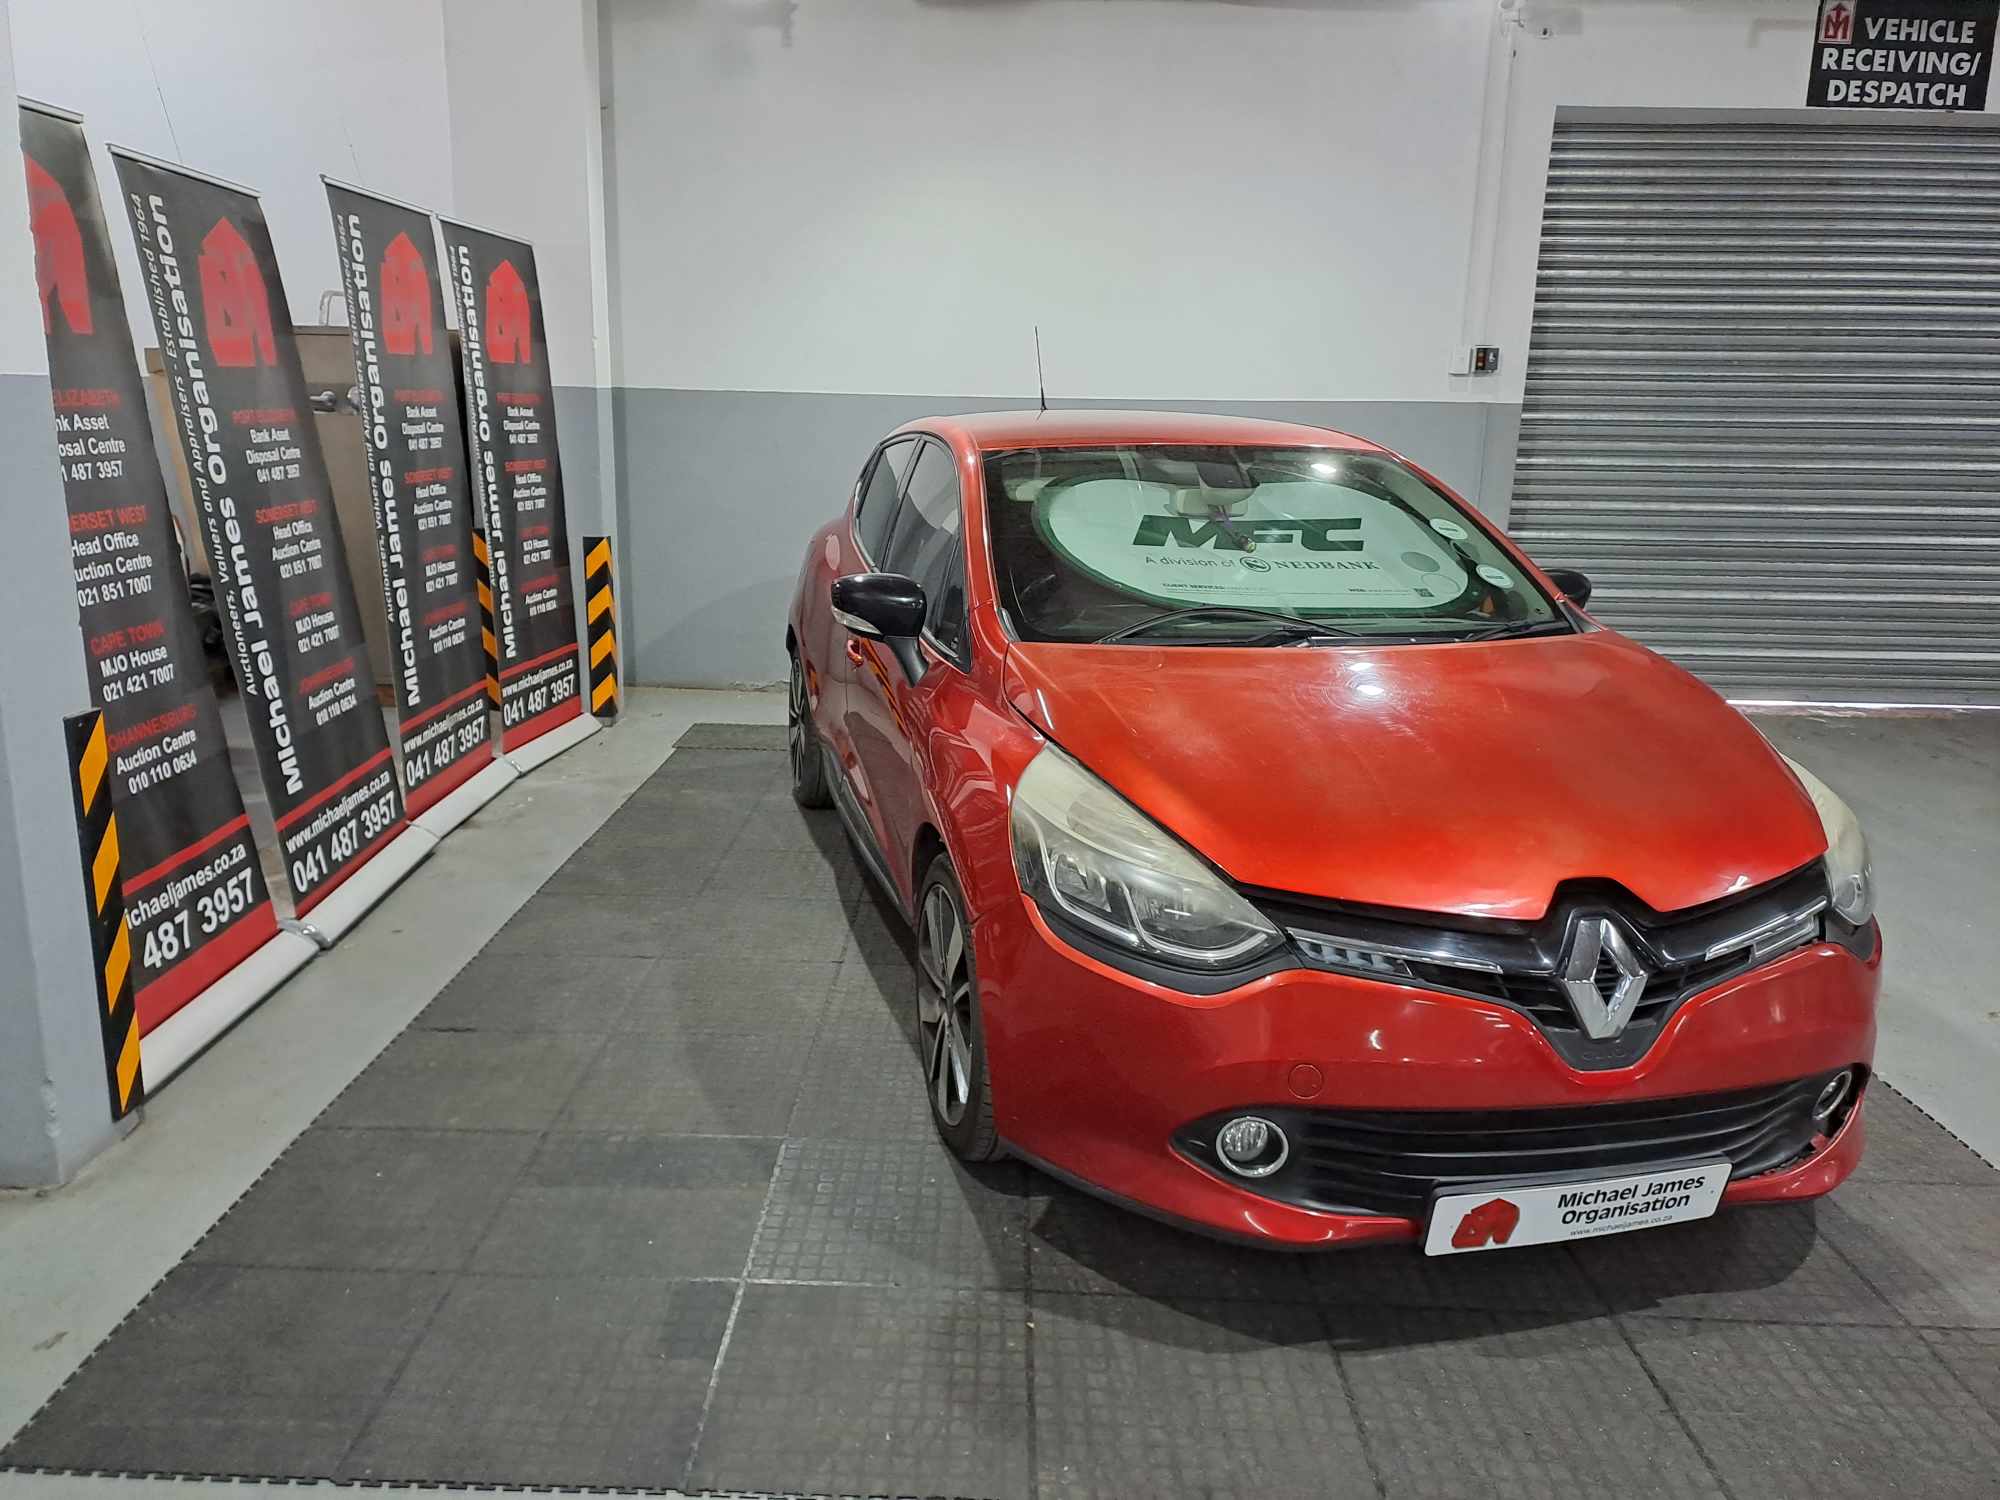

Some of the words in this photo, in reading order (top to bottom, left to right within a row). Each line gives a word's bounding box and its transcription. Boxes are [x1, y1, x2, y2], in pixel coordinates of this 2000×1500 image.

[1865, 17, 1977, 43] VEHICLE
[1821, 48, 1982, 76] RECEIVING/
[1827, 80, 1967, 106] DESPATCH
[131, 193, 150, 241] 1964
[143, 248, 177, 359] Established
[149, 194, 227, 485] Organisation
[348, 214, 388, 450] Organisation
[458, 246, 490, 442] Organisation
[74, 413, 110, 430] Asset
[87, 437, 127, 454] Centre
[174, 376, 204, 473] Appraisers
[71, 463, 92, 480] 487
[97, 460, 122, 478] 3957
[196, 477, 213, 513] and
[379, 460, 403, 569] James
[483, 450, 503, 543] James
[72, 536, 101, 557] Head
[103, 532, 139, 551] Office
[115, 553, 152, 573] Centre
[207, 517, 229, 583] Valuers
[219, 497, 263, 629] James
[1145, 556, 1157, 566] A
[1160, 555, 1218, 568] division
[1220, 559, 1236, 567] of
[1274, 560, 1382, 571] NEDBANK
[78, 586, 100, 607] 021
[101, 581, 124, 602] 851
[126, 575, 152, 596] 7007
[494, 551, 518, 658] Michael
[100, 652, 128, 678] MJO
[129, 645, 168, 668] House
[226, 590, 258, 695] Auctioneers,
[392, 578, 421, 706] Michael
[102, 680, 124, 702] 021
[126, 673, 148, 694] 421
[150, 663, 174, 686] 7007
[503, 704, 525, 727] 041
[527, 687, 547, 715] 487
[551, 674, 576, 704] 3957
[251, 639, 303, 795] Michael
[116, 744, 161, 775] Auction
[162, 728, 197, 754] Centre
[128, 771, 149, 794] 010
[150, 762, 171, 783] 110
[173, 749, 197, 774] 0634
[406, 751, 431, 786] 041
[434, 735, 455, 770] 487
[458, 716, 486, 752] 3957
[286, 771, 390, 854] www.michaeljames.co.za
[292, 844, 328, 893] 041
[331, 819, 359, 863] 487
[361, 791, 396, 839] 3957
[143, 909, 191, 969] 487
[197, 867, 254, 934] 3957
[1558, 1184, 1638, 1208] Michael
[1642, 1176, 1705, 1197] James
[1562, 1194, 1690, 1225] Organisation
[1570, 1215, 1673, 1237] www.michaeljames.co.za
